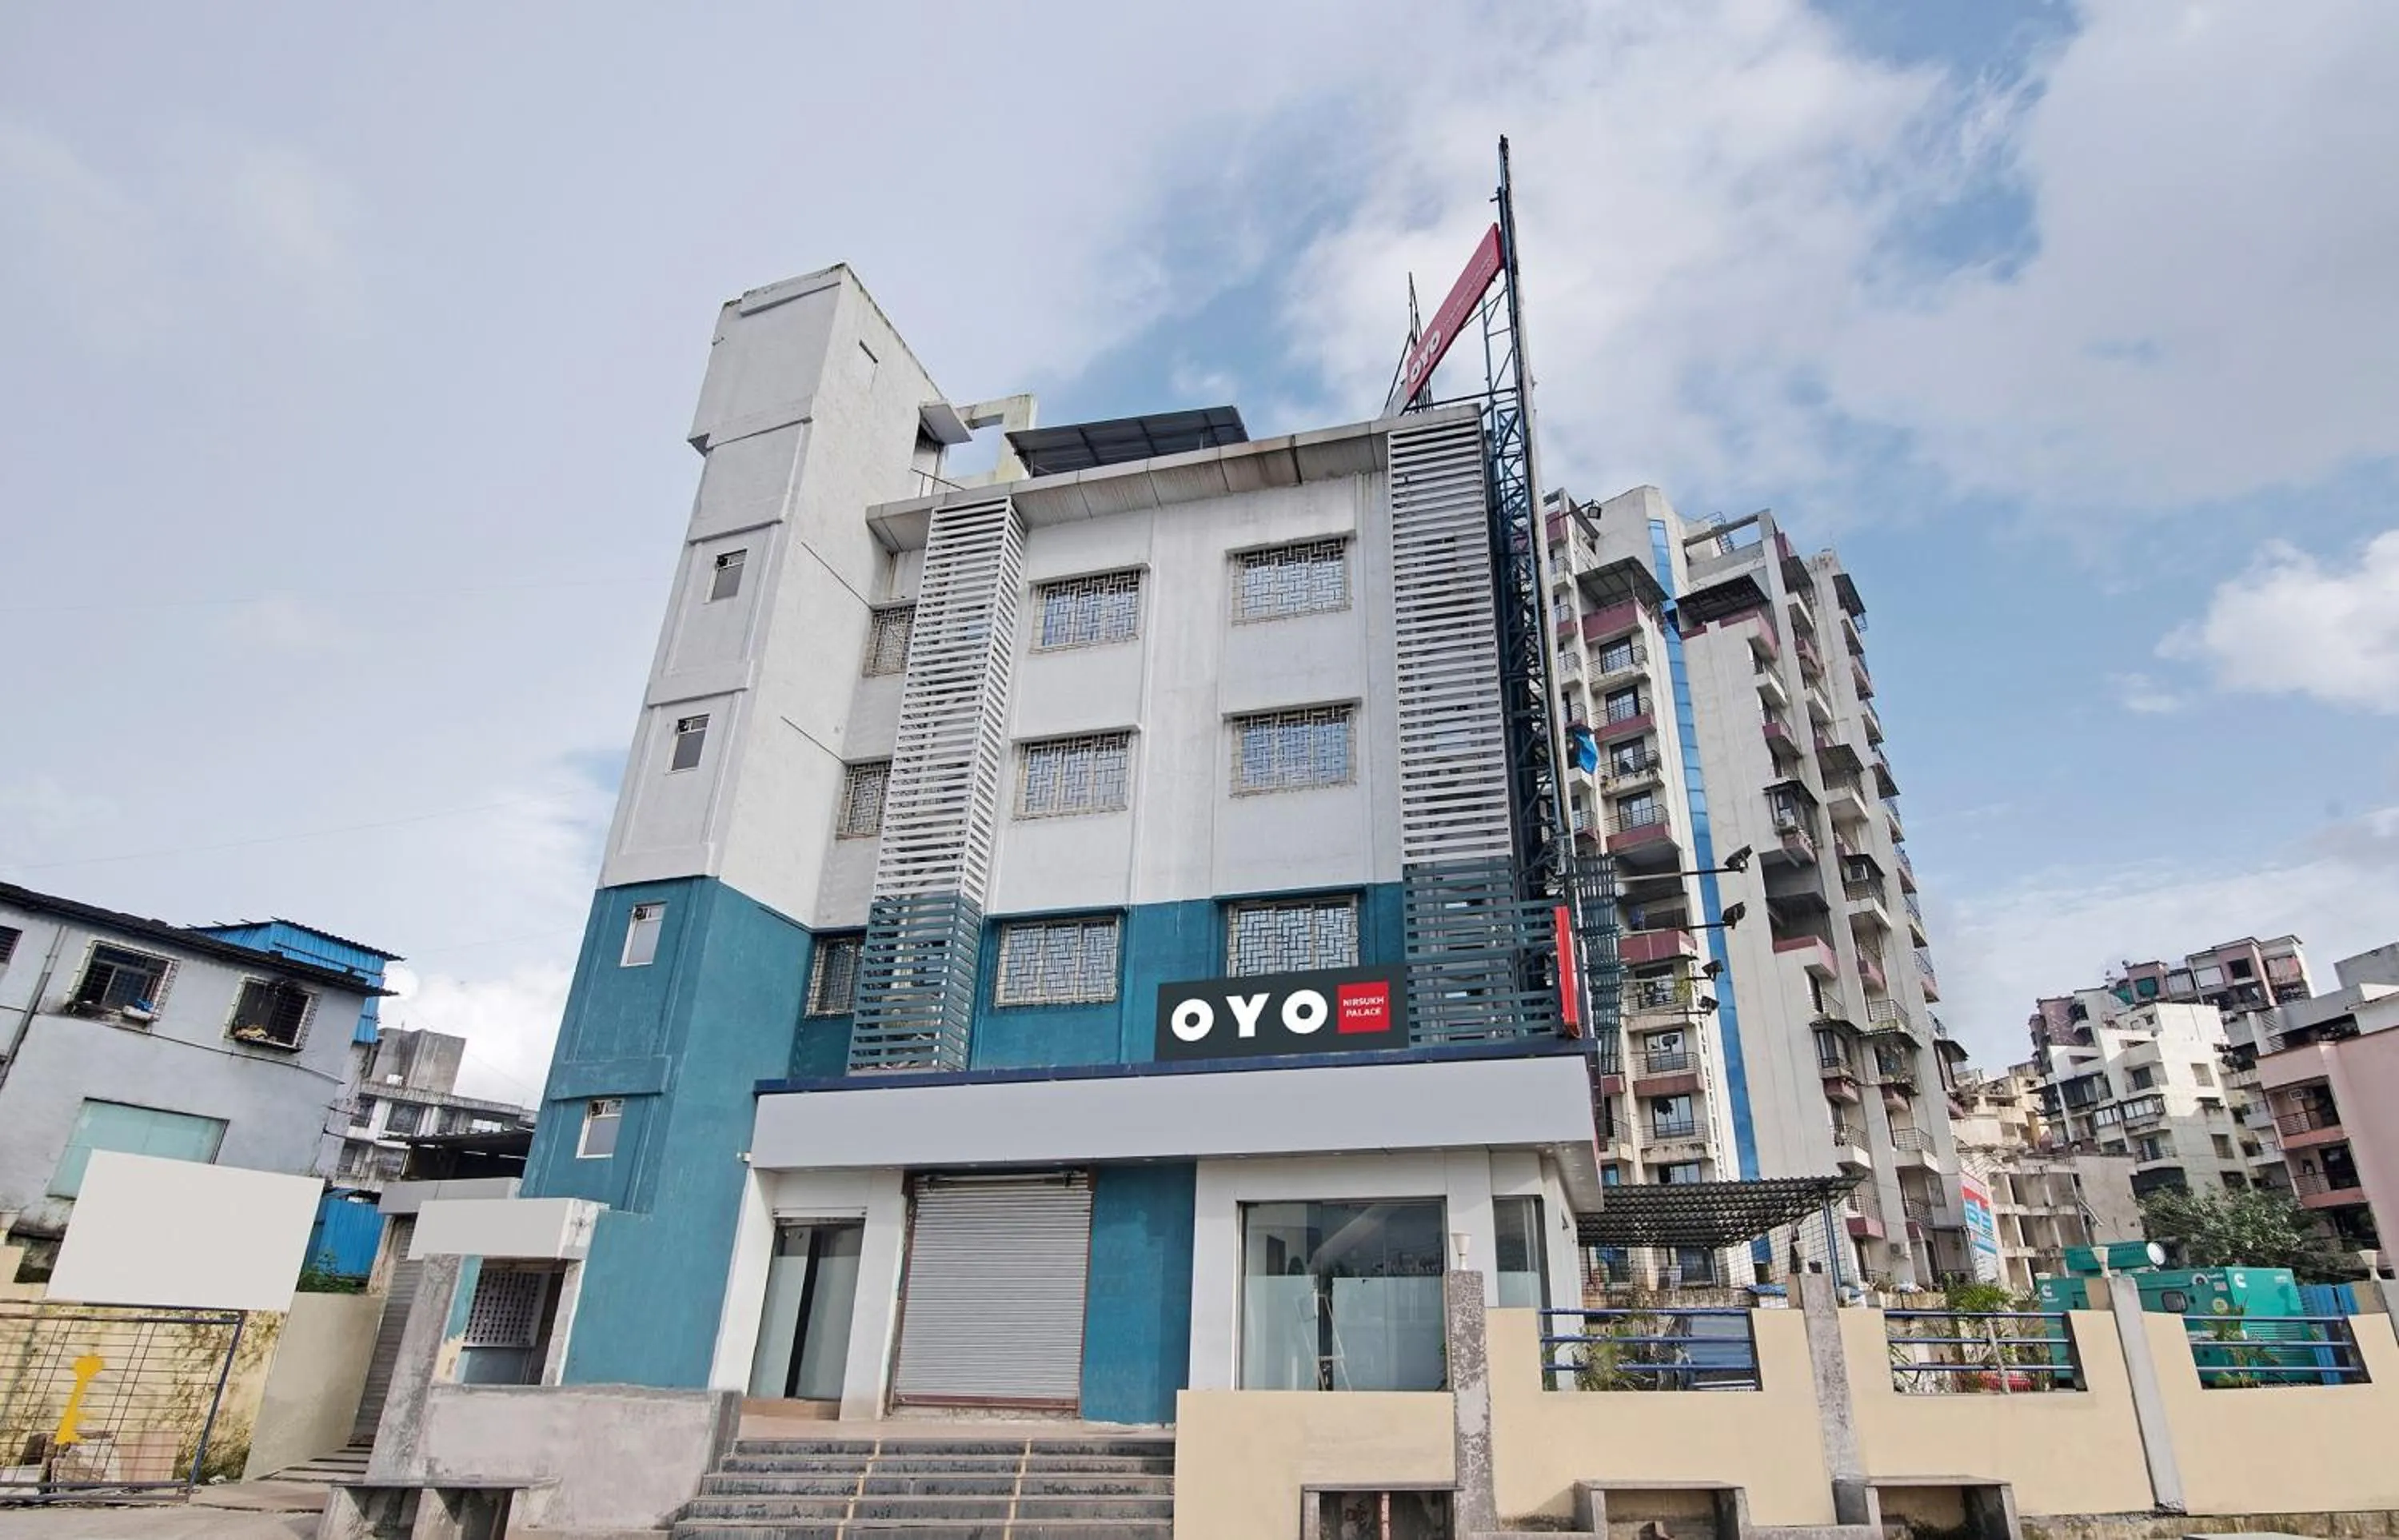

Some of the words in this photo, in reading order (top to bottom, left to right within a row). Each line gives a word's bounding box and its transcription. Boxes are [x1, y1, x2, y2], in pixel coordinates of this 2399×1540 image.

[1410, 329, 1441, 383] OYO
[1171, 989, 1328, 1042] OYO
[1343, 996, 1384, 1006] NIRSUKH
[1346, 1007, 1382, 1017] PALACE
